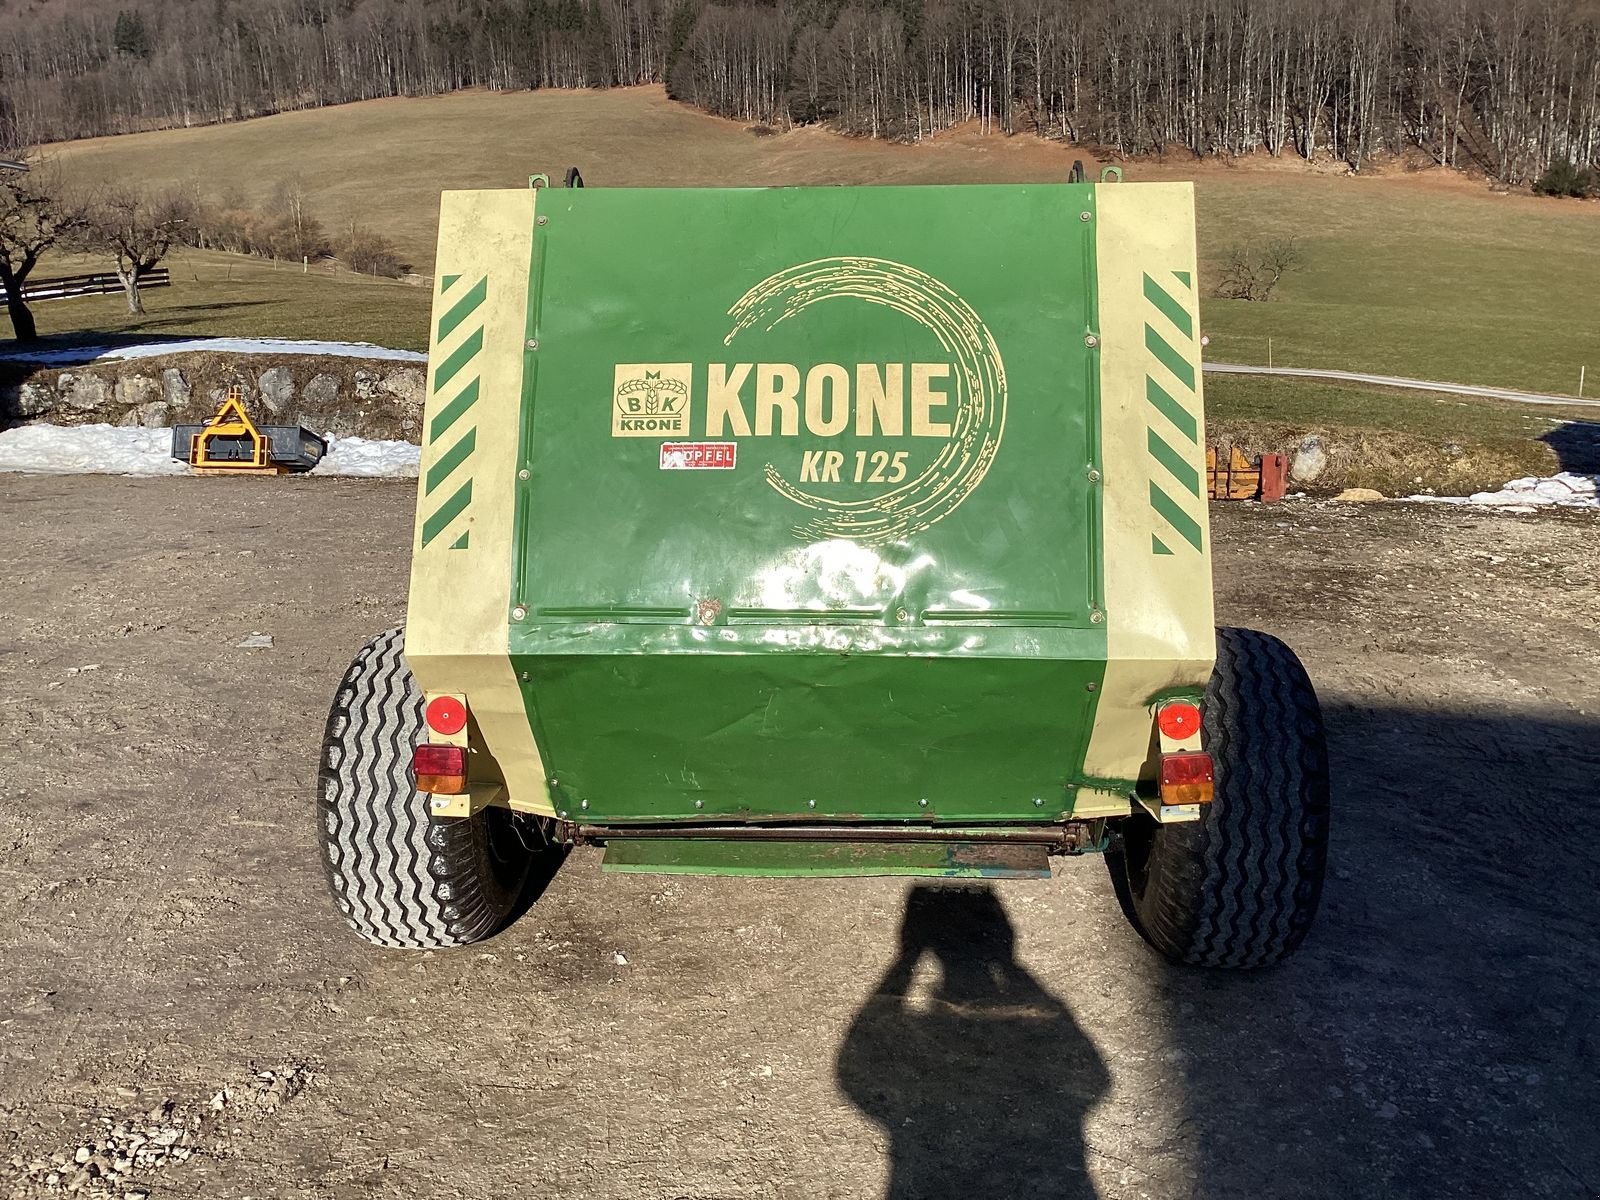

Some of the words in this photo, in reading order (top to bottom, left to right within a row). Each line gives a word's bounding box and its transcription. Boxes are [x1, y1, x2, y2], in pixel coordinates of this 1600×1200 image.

[645, 370, 660, 380] M
[627, 397, 641, 412] B
[661, 396, 678, 412] K
[705, 363, 951, 437] KRONE
[620, 419, 682, 431] KRONE
[663, 449, 733, 461] KÖPFEL
[799, 450, 844, 483] KR
[854, 450, 909, 484] 125
